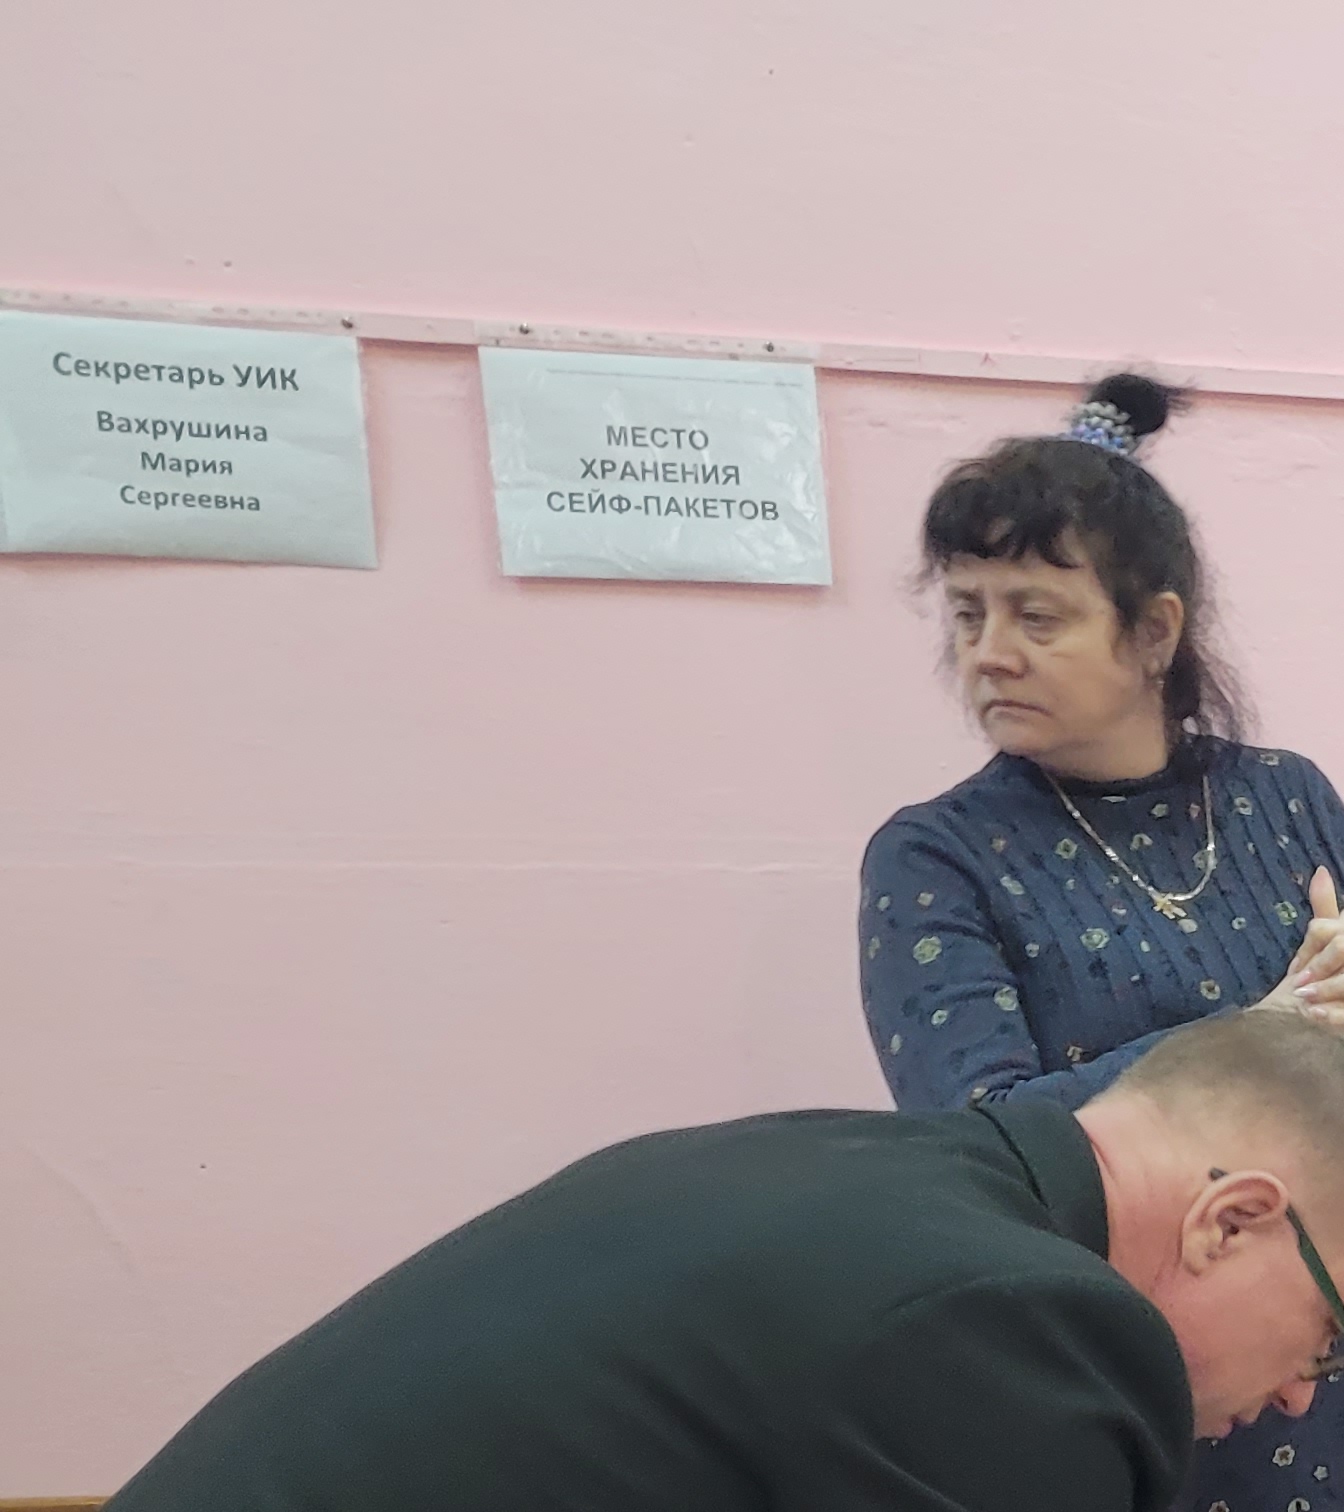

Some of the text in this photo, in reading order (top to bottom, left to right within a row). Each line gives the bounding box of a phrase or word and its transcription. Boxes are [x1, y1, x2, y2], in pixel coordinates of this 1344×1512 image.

[52, 351, 299, 391] Секретарь УИК
[96, 410, 267, 442] Вахрушина
[606, 425, 709, 450] МЕСТО
[140, 451, 233, 478] Мария
[579, 458, 741, 485] ХРАНЕНИЯ
[120, 485, 260, 511] Сергеевна
[546, 488, 780, 521] СЕЙФ-ПАКЕТОВ
